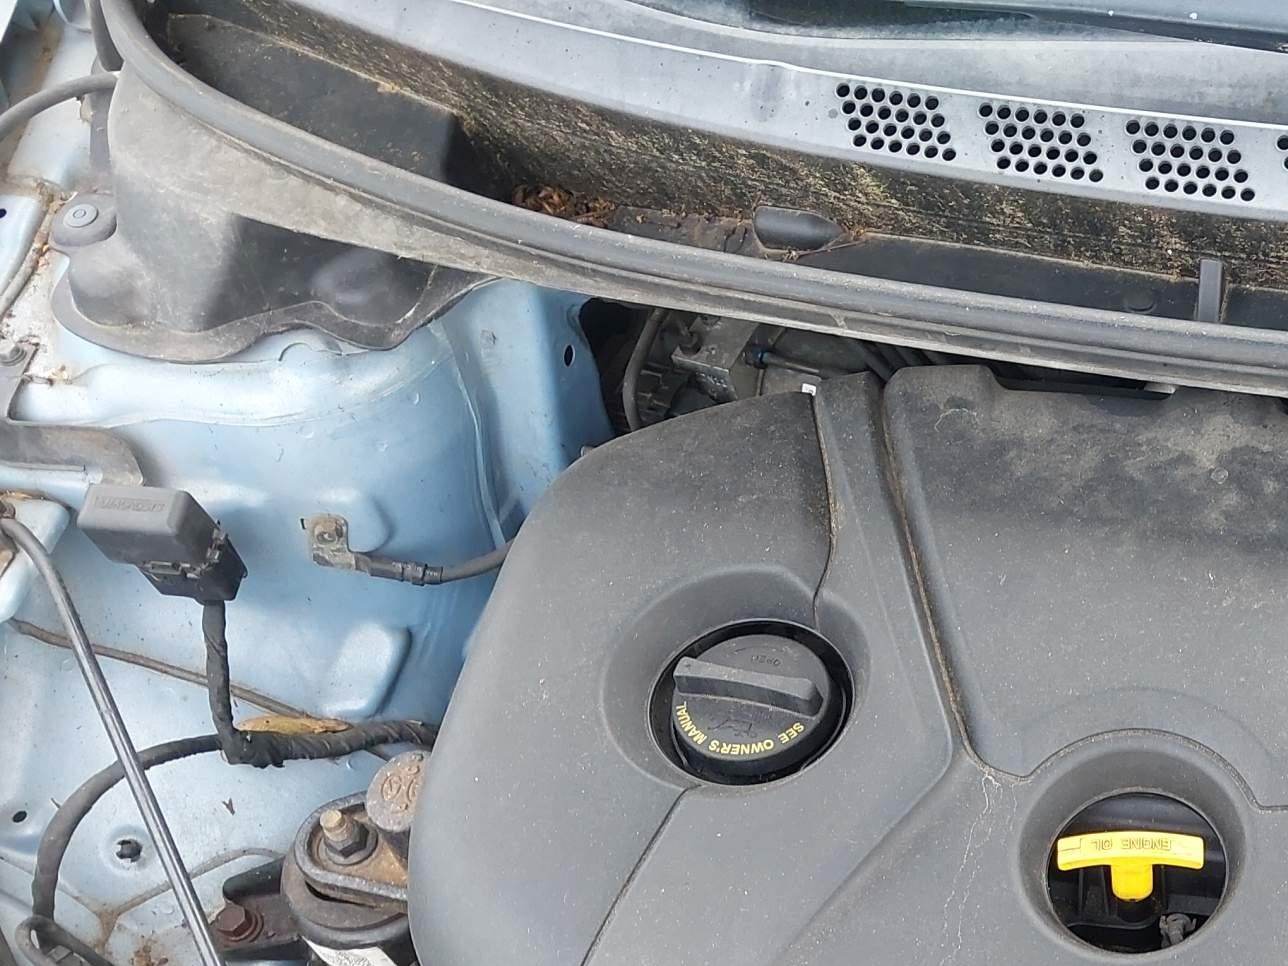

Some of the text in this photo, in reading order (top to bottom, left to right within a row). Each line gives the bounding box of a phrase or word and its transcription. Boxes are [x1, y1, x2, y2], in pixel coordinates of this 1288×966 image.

[674, 701, 805, 755] SEE OWNER'S MANUAL
[1090, 837, 1172, 852] ENGINE OIL
